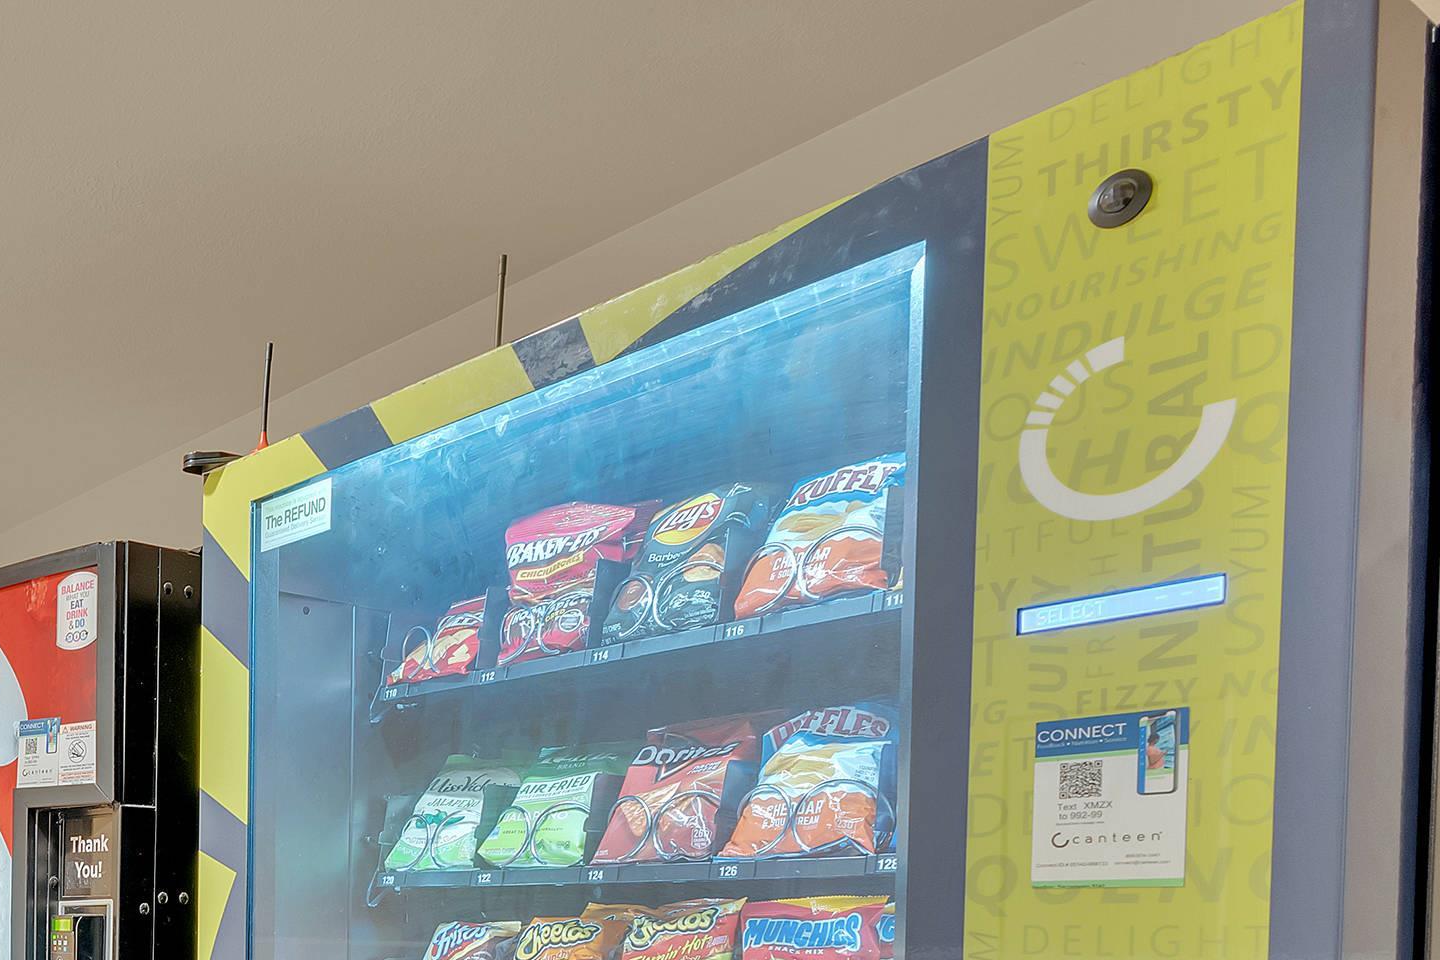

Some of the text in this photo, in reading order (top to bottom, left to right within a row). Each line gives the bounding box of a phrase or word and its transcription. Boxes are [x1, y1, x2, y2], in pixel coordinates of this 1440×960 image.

[1038, 67, 1297, 198] THIRSTY
[982, 210, 1284, 334] NOURISHING
[266, 496, 326, 530] The REFUND
[61, 580, 95, 595] BALANCE
[70, 598, 84, 610] EAT
[66, 608, 88, 620] DRINK
[68, 618, 85, 630] & DO
[726, 626, 744, 636] 116
[592, 650, 608, 661] 114
[482, 672, 495, 682] 112
[1076, 677, 1200, 715] FIZZY
[1037, 722, 1128, 743] CONNECT
[632, 742, 740, 765] Doritos
[520, 775, 591, 795] AIR FRIED
[1058, 800, 1114, 812] Text XMZX
[1059, 810, 1103, 820] to 992-99
[70, 833, 109, 855] Thank
[1072, 832, 1162, 845] canteen
[74, 861, 102, 879] You!
[588, 870, 604, 880] 124
[720, 866, 738, 877] 126
[478, 874, 492, 882] 122
[743, 912, 862, 952] MUNCHIES
